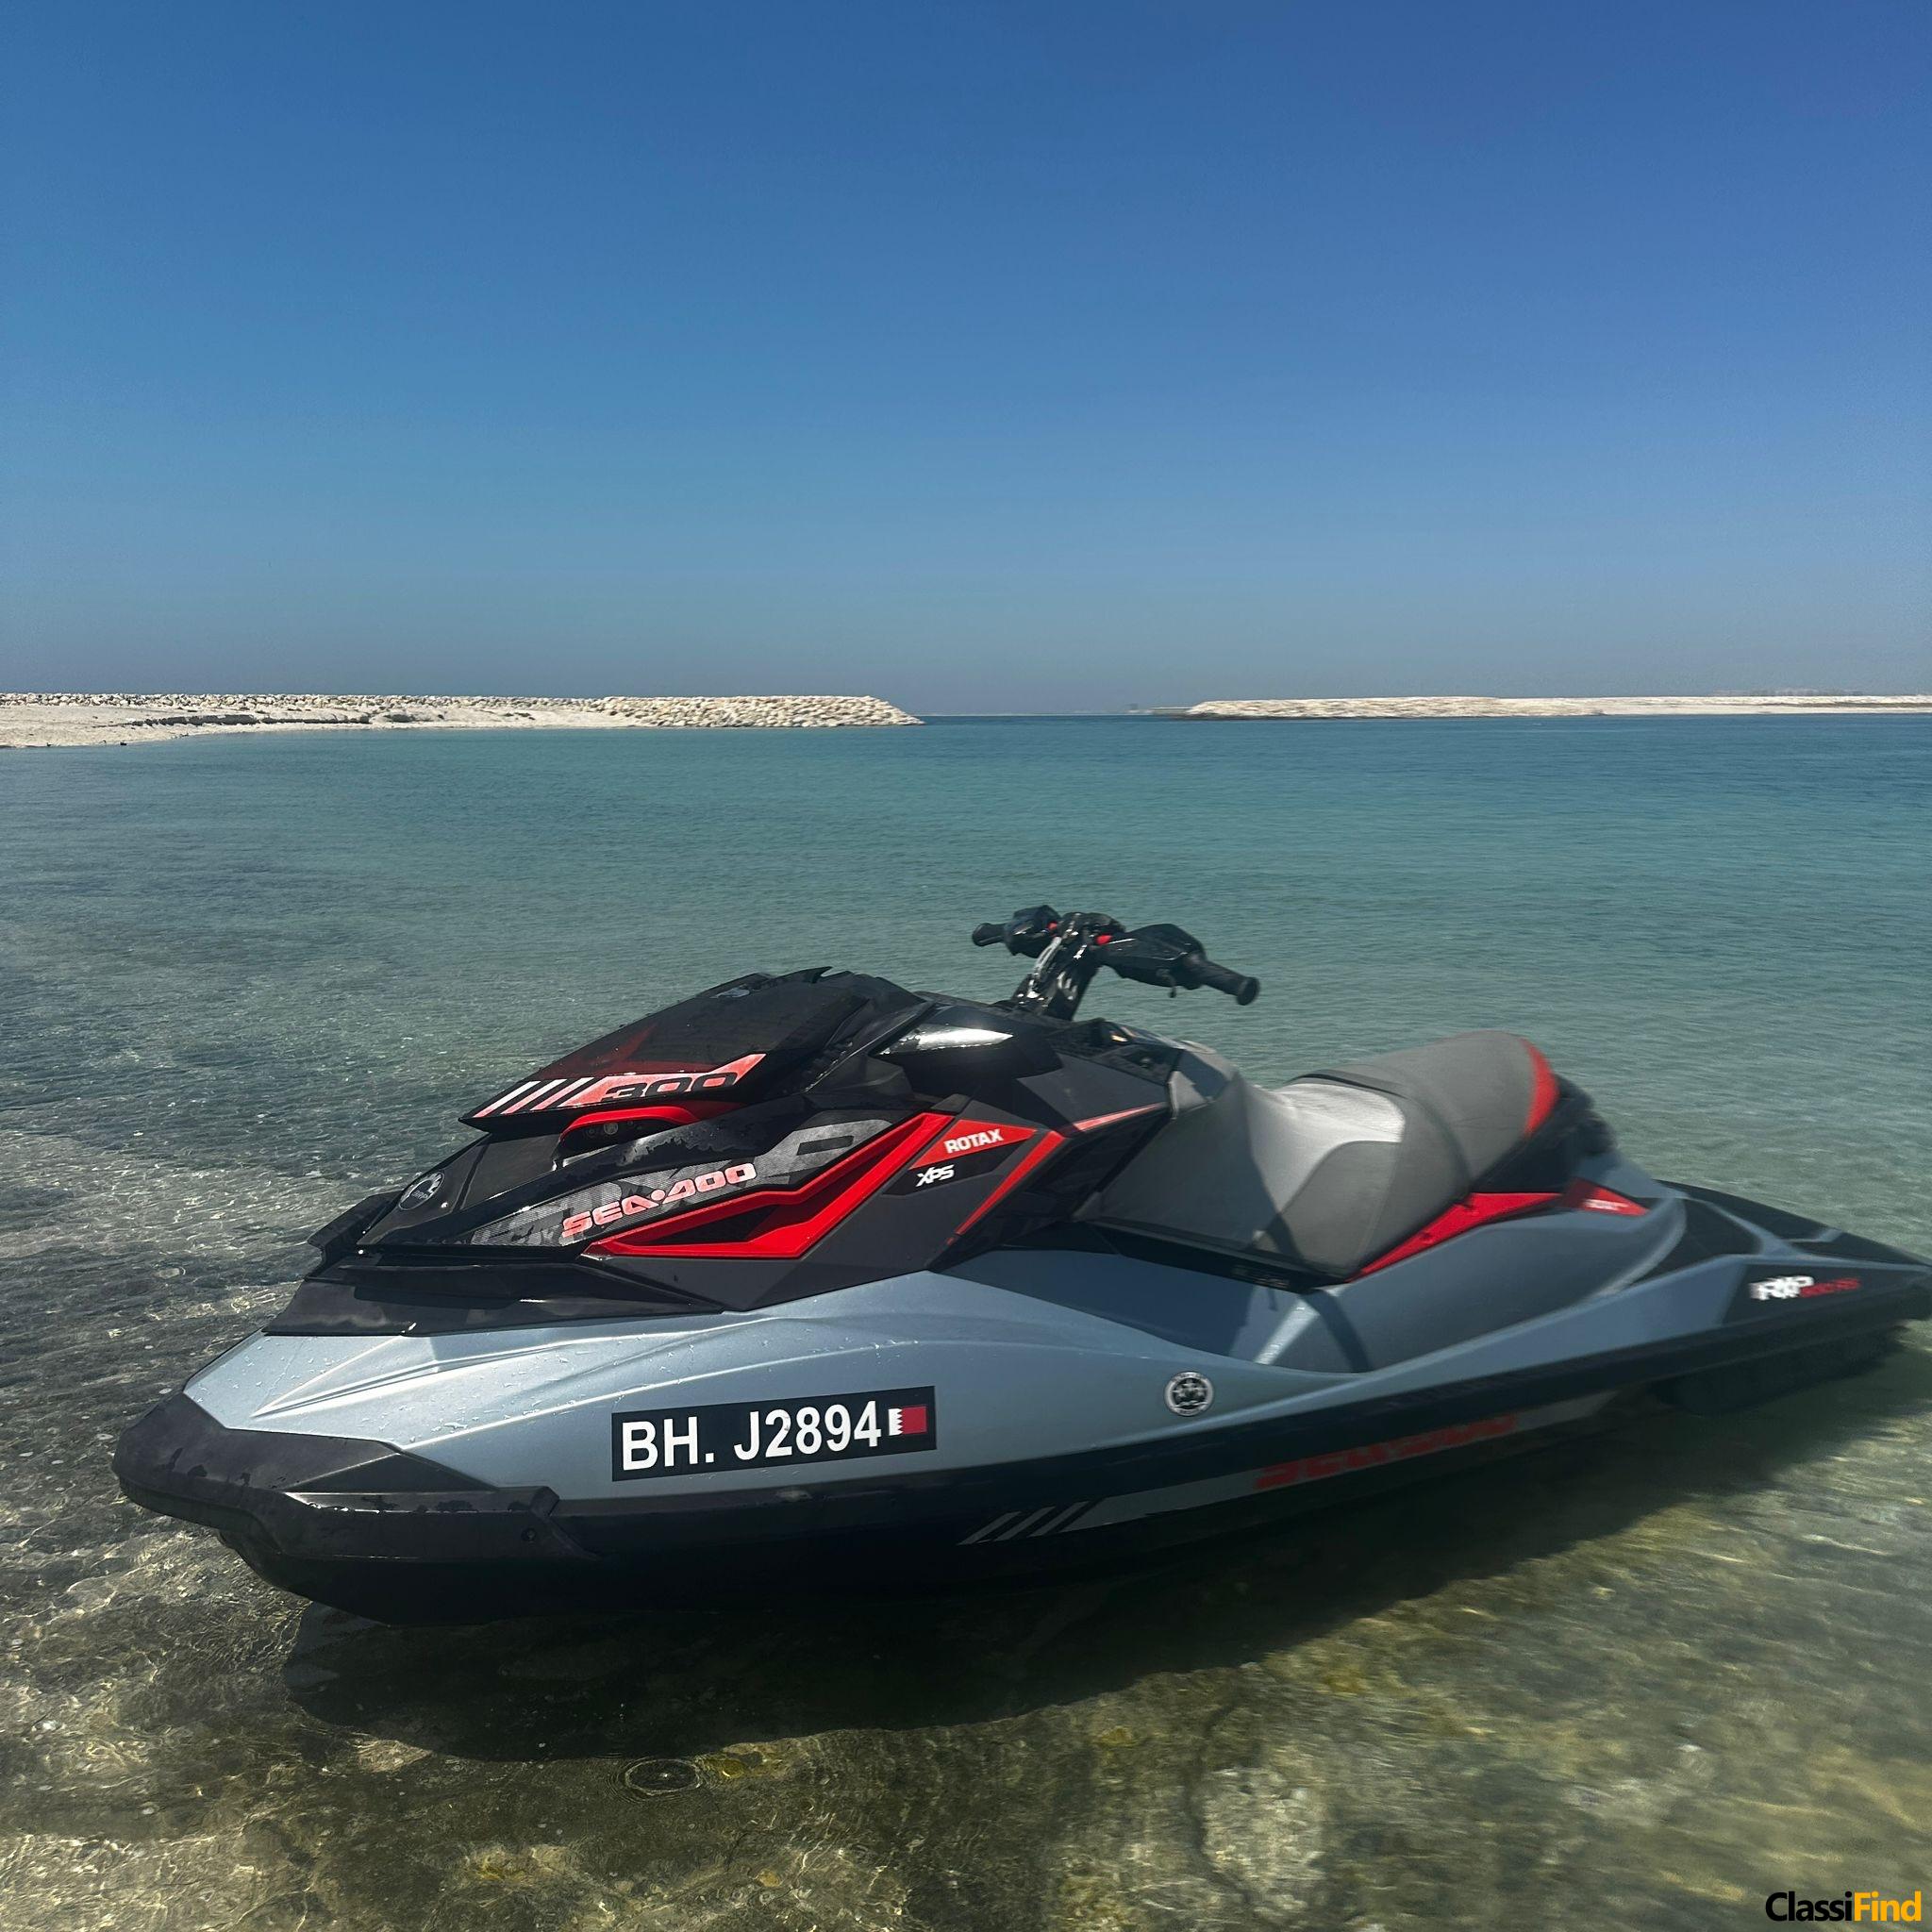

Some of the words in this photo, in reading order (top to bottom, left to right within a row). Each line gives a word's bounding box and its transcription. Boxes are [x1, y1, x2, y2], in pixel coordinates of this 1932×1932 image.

[600, 1072, 739, 1102] 300
[943, 1128, 1004, 1154] ROTAX
[916, 1164, 955, 1187] XPS
[622, 1415, 714, 1472] BH.
[733, 1400, 882, 1461] J2894
